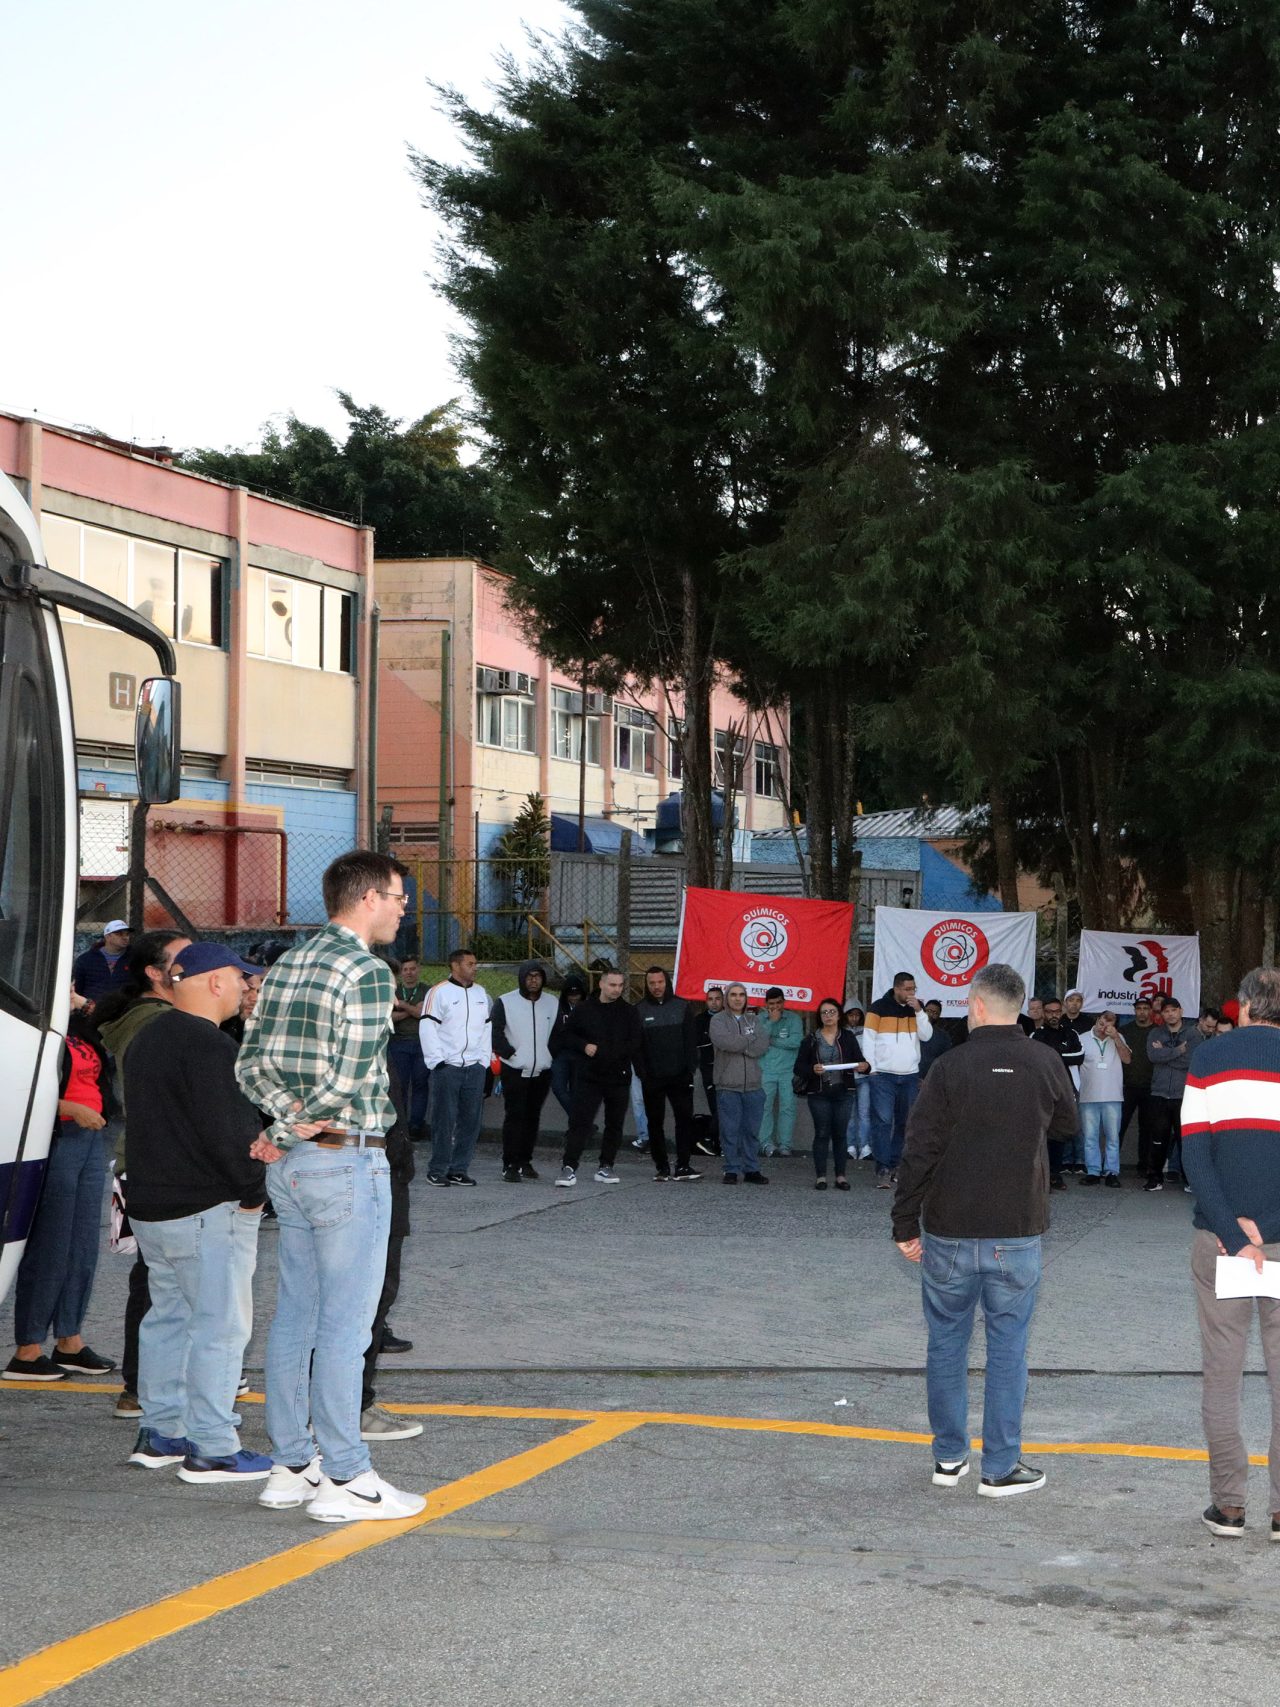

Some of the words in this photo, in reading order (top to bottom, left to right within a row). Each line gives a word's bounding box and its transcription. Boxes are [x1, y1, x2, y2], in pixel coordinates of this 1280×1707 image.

[115, 678, 130, 705] H
[743, 907, 790, 926] QUÍMICOS
[933, 922, 978, 938] QUÍMICOS
